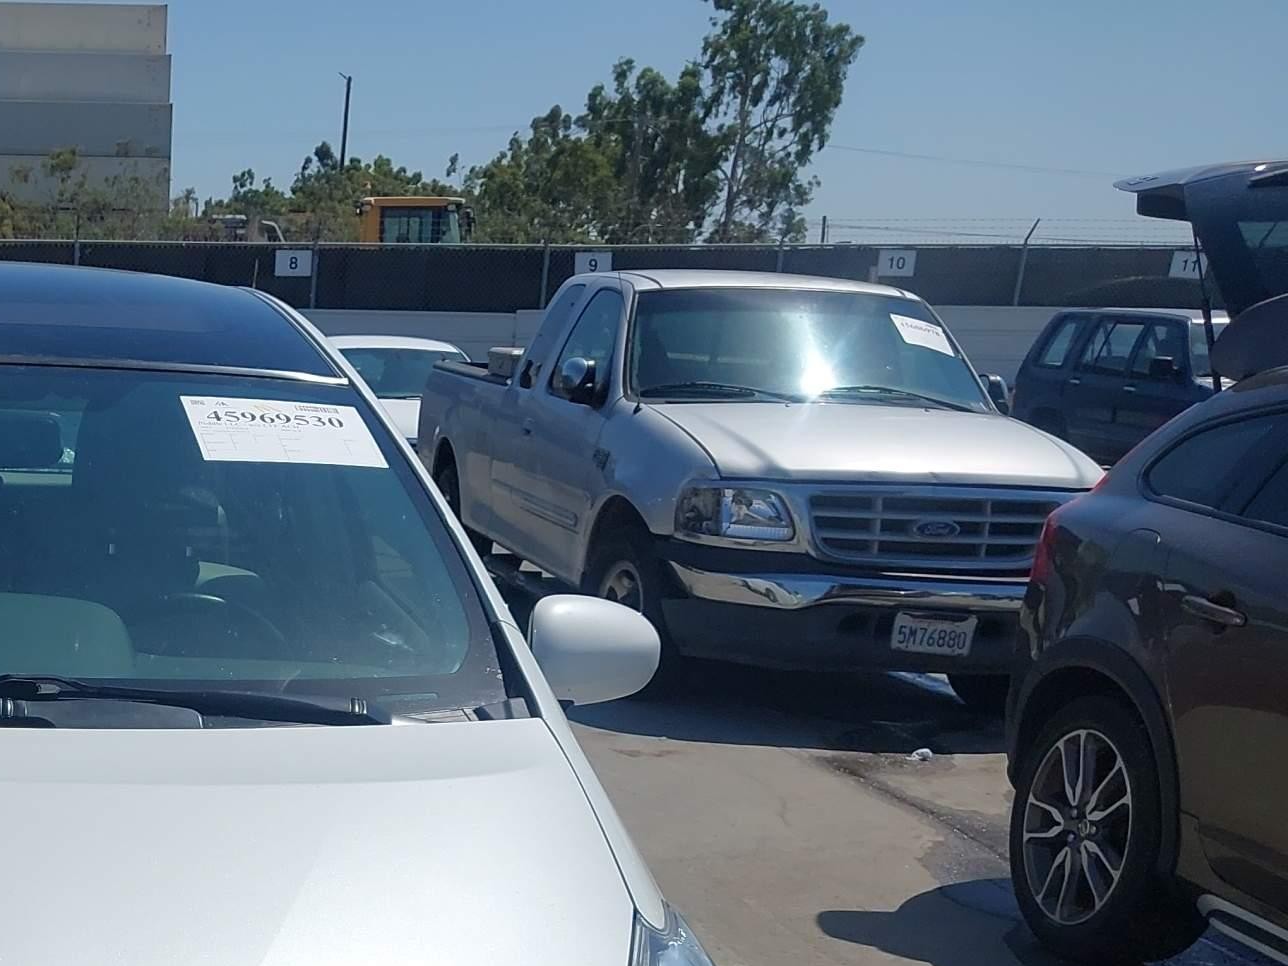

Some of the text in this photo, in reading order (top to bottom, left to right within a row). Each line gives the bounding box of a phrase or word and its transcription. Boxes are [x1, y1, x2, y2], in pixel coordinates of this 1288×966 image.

[288, 256, 299, 270] 8
[588, 258, 598, 272] 9
[888, 256, 907, 270] 10
[206, 410, 344, 428] 45969530
[897, 625, 968, 650] 5M76880
